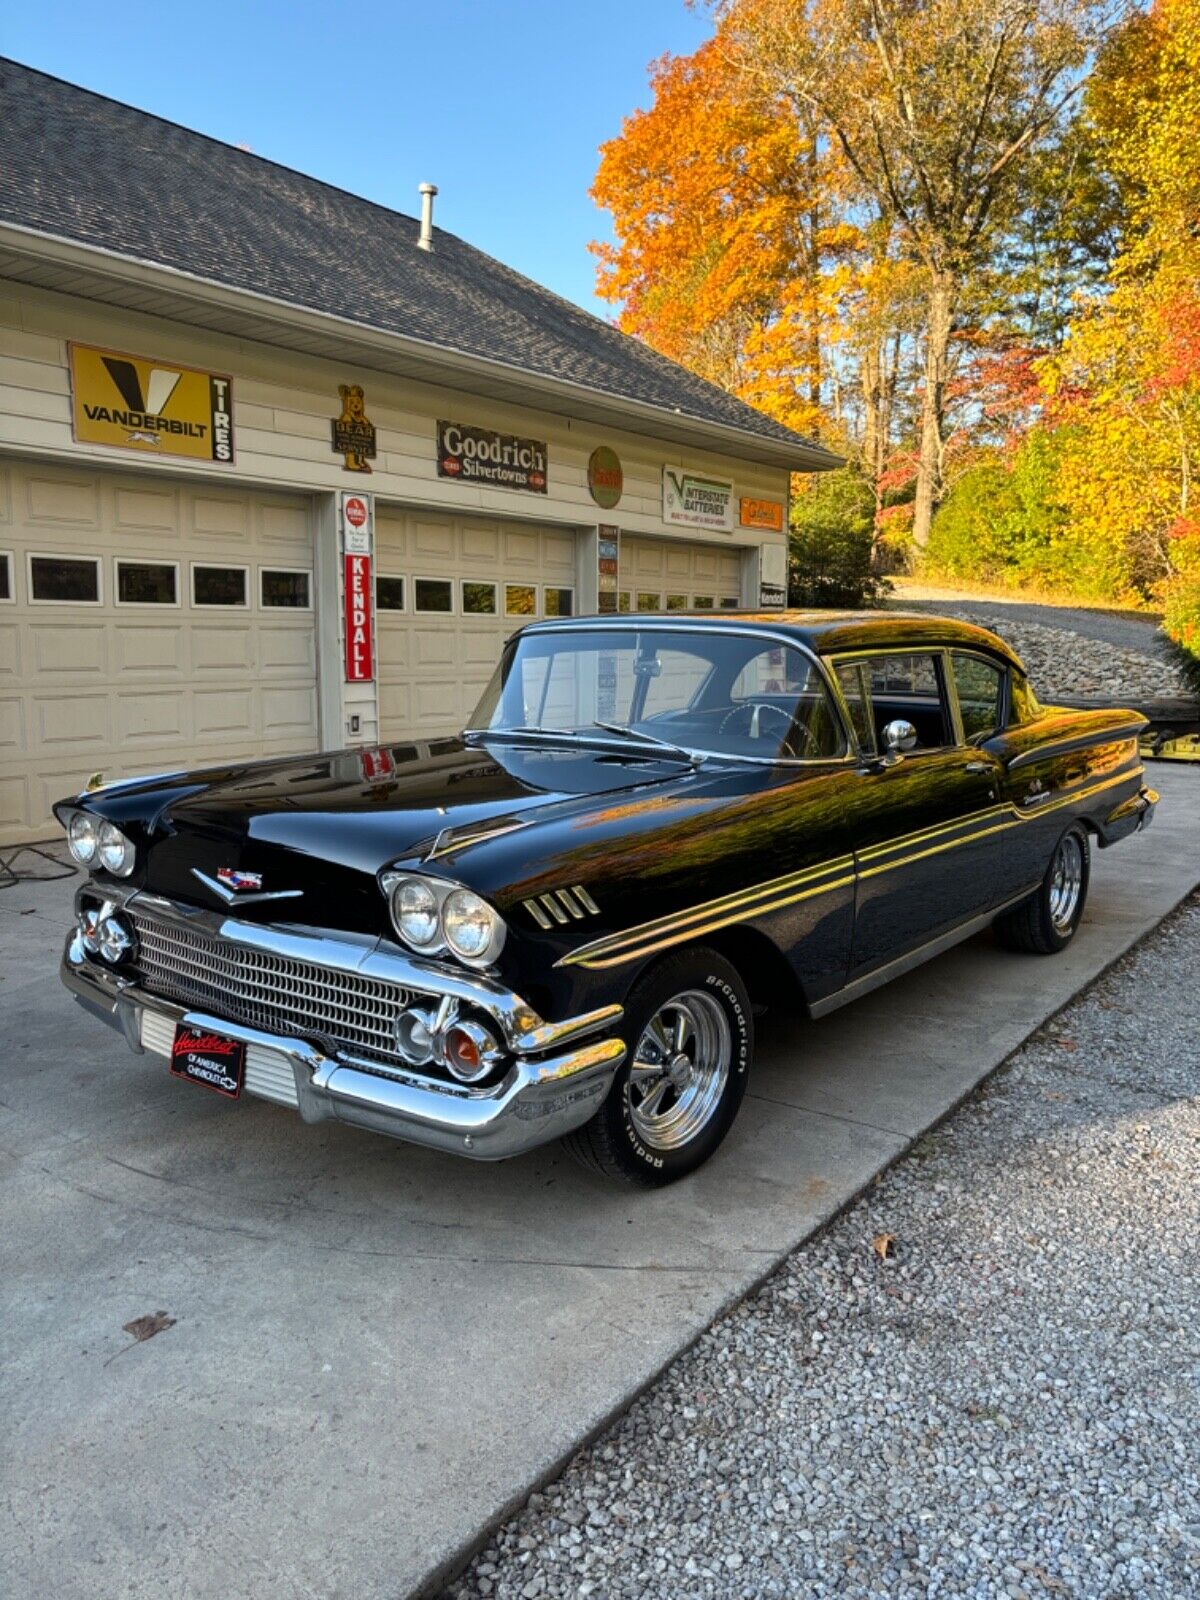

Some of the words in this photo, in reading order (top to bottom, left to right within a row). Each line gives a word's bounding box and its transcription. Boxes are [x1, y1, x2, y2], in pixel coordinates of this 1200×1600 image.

[83, 404, 208, 438] VANDERBILT
[213, 379, 231, 460] TIRES
[443, 426, 544, 471] Goodrich
[462, 458, 528, 484] Silvertowns
[684, 500, 725, 516] BATTERIES
[685, 487, 730, 505] INTERSTATE
[353, 557, 366, 679] KENDALL
[187, 1064, 221, 1083] CHEVROLET
[196, 1056, 227, 1075] AMERICA
